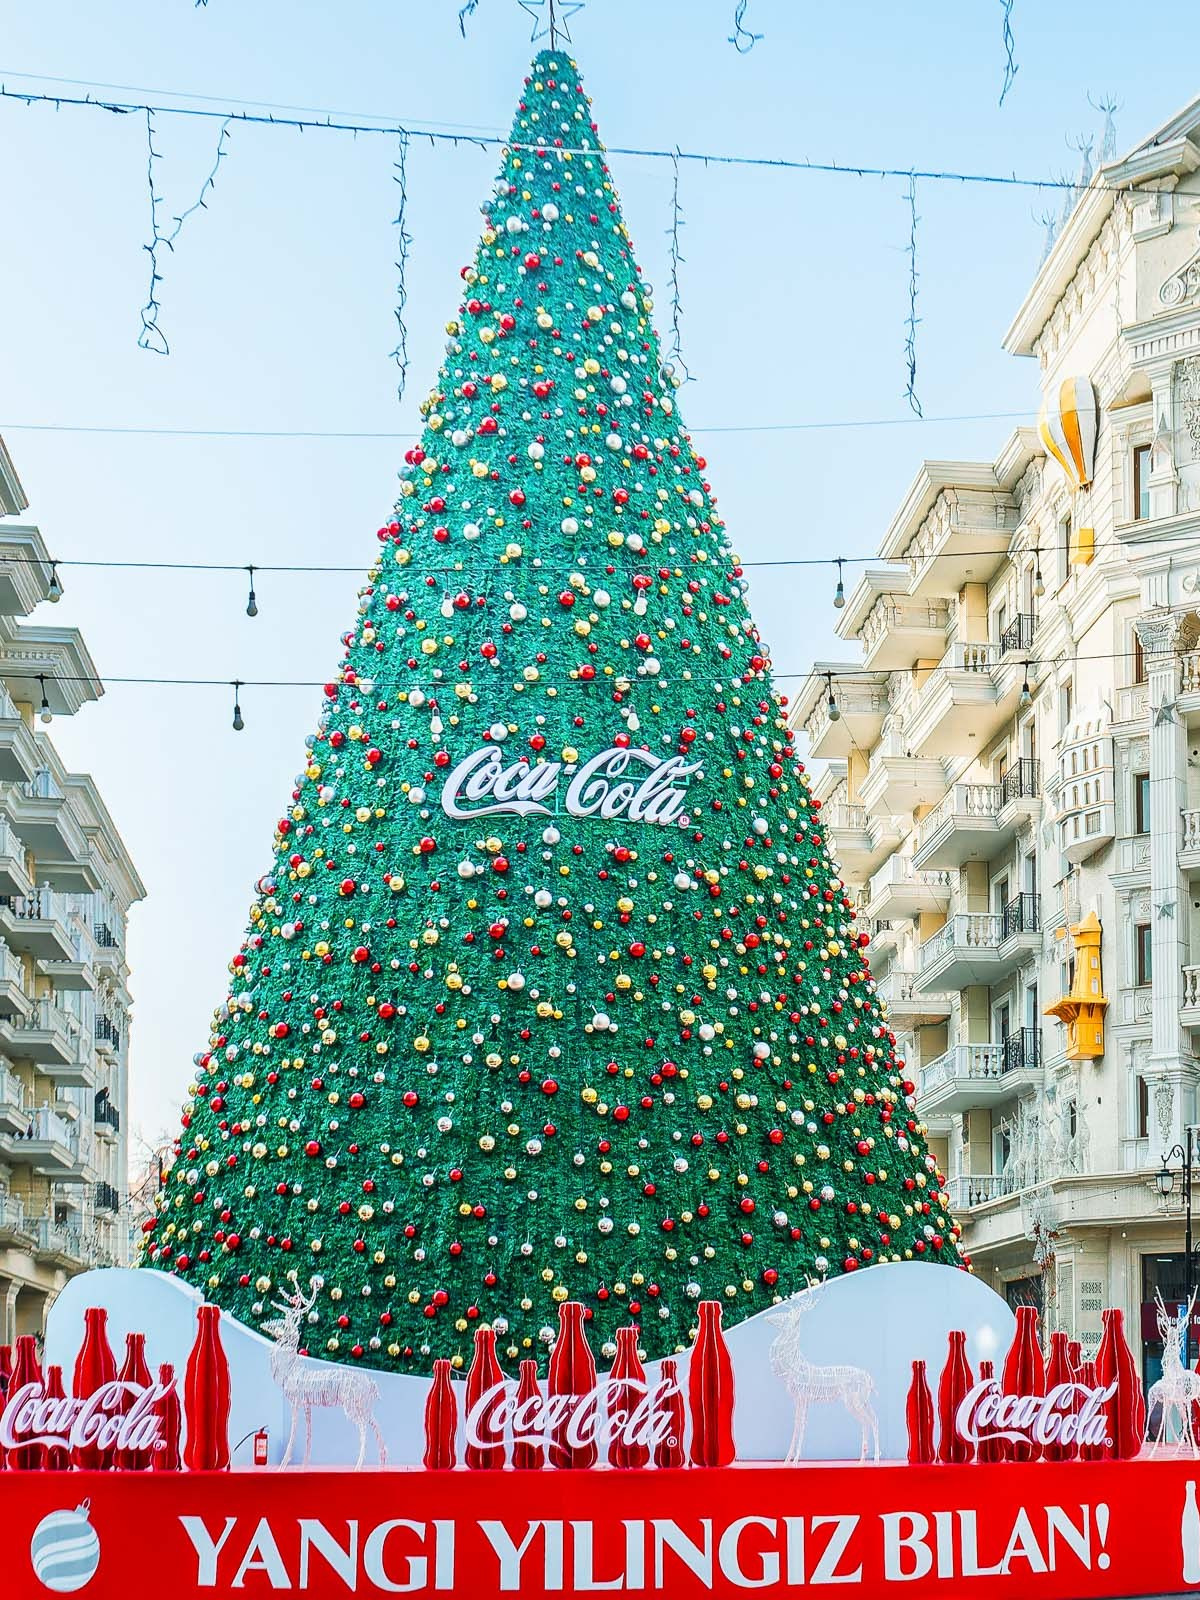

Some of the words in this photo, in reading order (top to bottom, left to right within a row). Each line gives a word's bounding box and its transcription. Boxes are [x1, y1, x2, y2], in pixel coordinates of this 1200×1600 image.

[441, 745, 704, 827] Coca-Cola
[0, 1379, 177, 1450] Coca-Cola
[466, 1376, 686, 1449] Coca-Cola
[956, 1378, 1118, 1446] Coca-Cola
[178, 1515, 456, 1592] YANGI
[476, 1514, 864, 1591] YILINGIZ
[878, 1503, 1111, 1581] BILAN!
